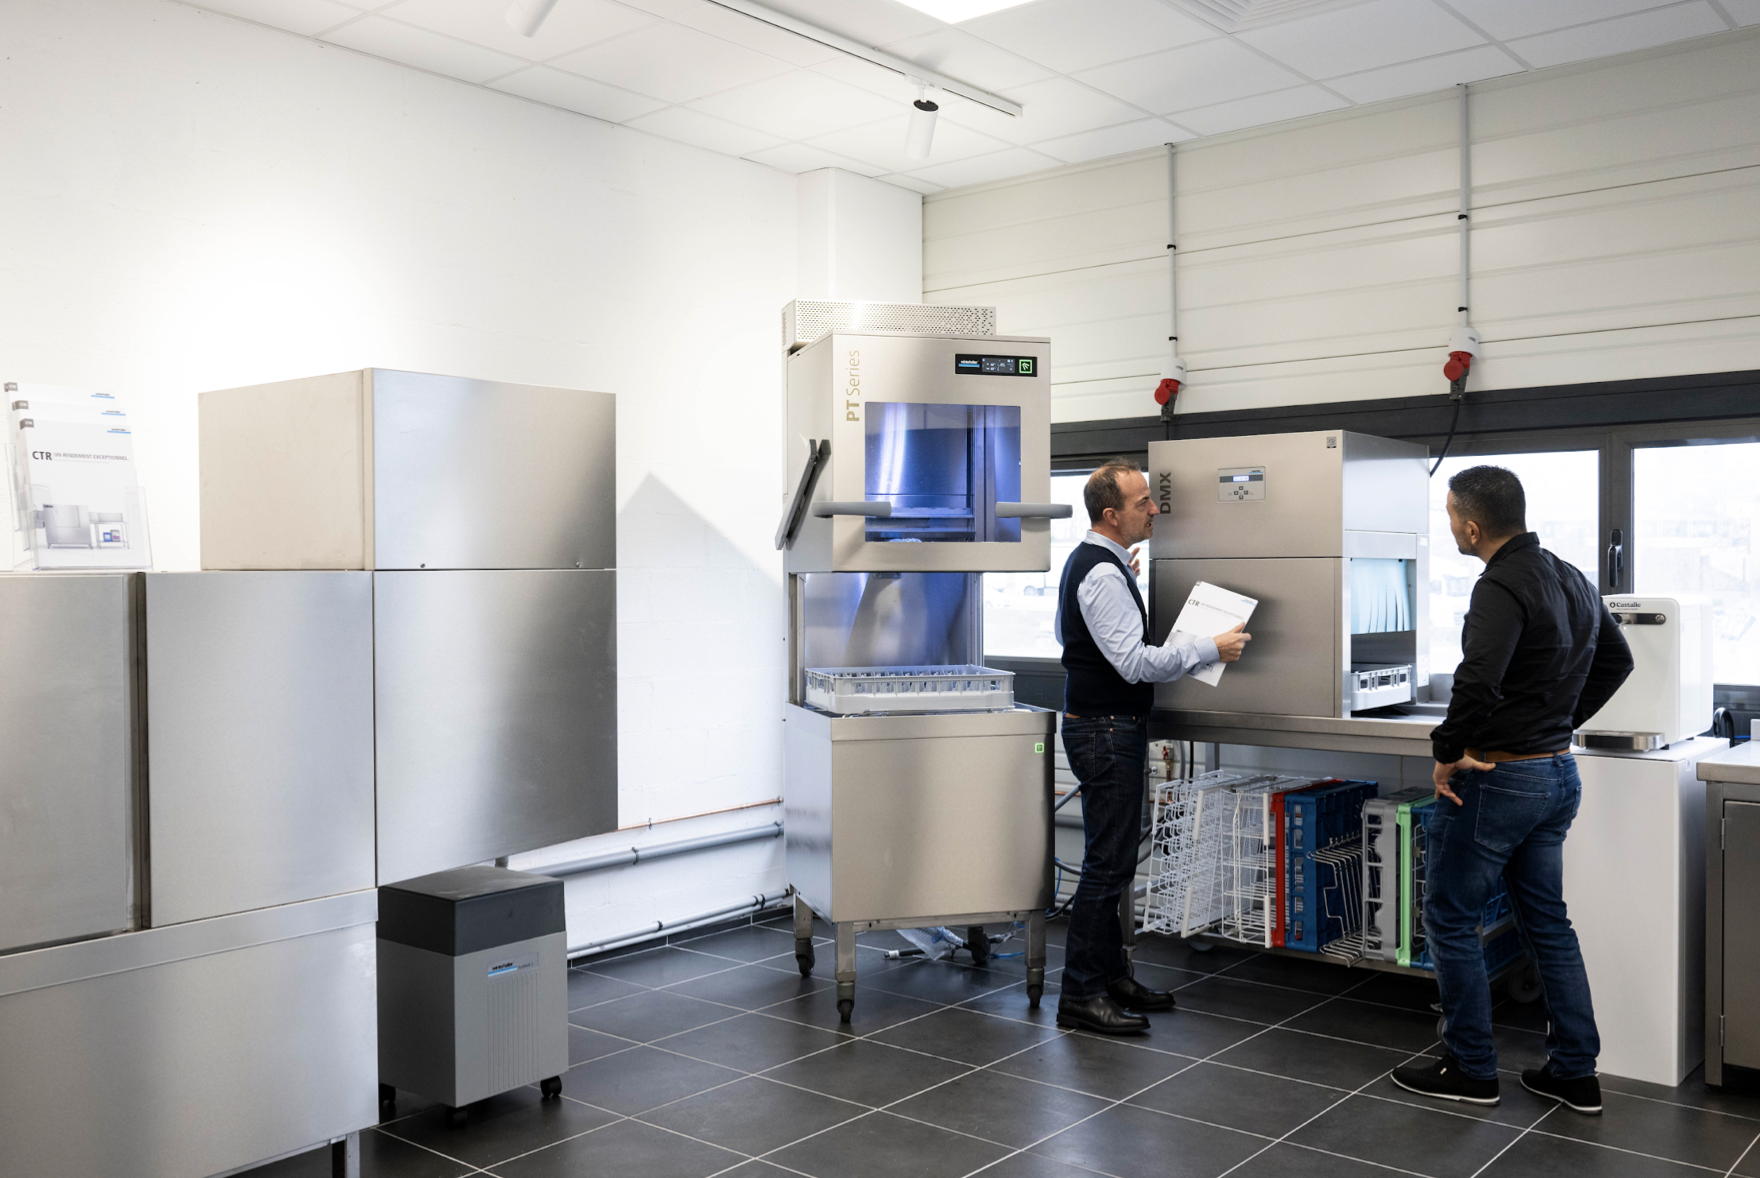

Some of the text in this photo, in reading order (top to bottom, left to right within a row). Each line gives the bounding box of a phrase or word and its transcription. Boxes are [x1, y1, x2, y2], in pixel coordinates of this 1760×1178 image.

[846, 350, 860, 421] PT Series
[32, 451, 52, 460] CTR
[1160, 472, 1171, 514] DMX
[1188, 598, 1200, 607] CTR
